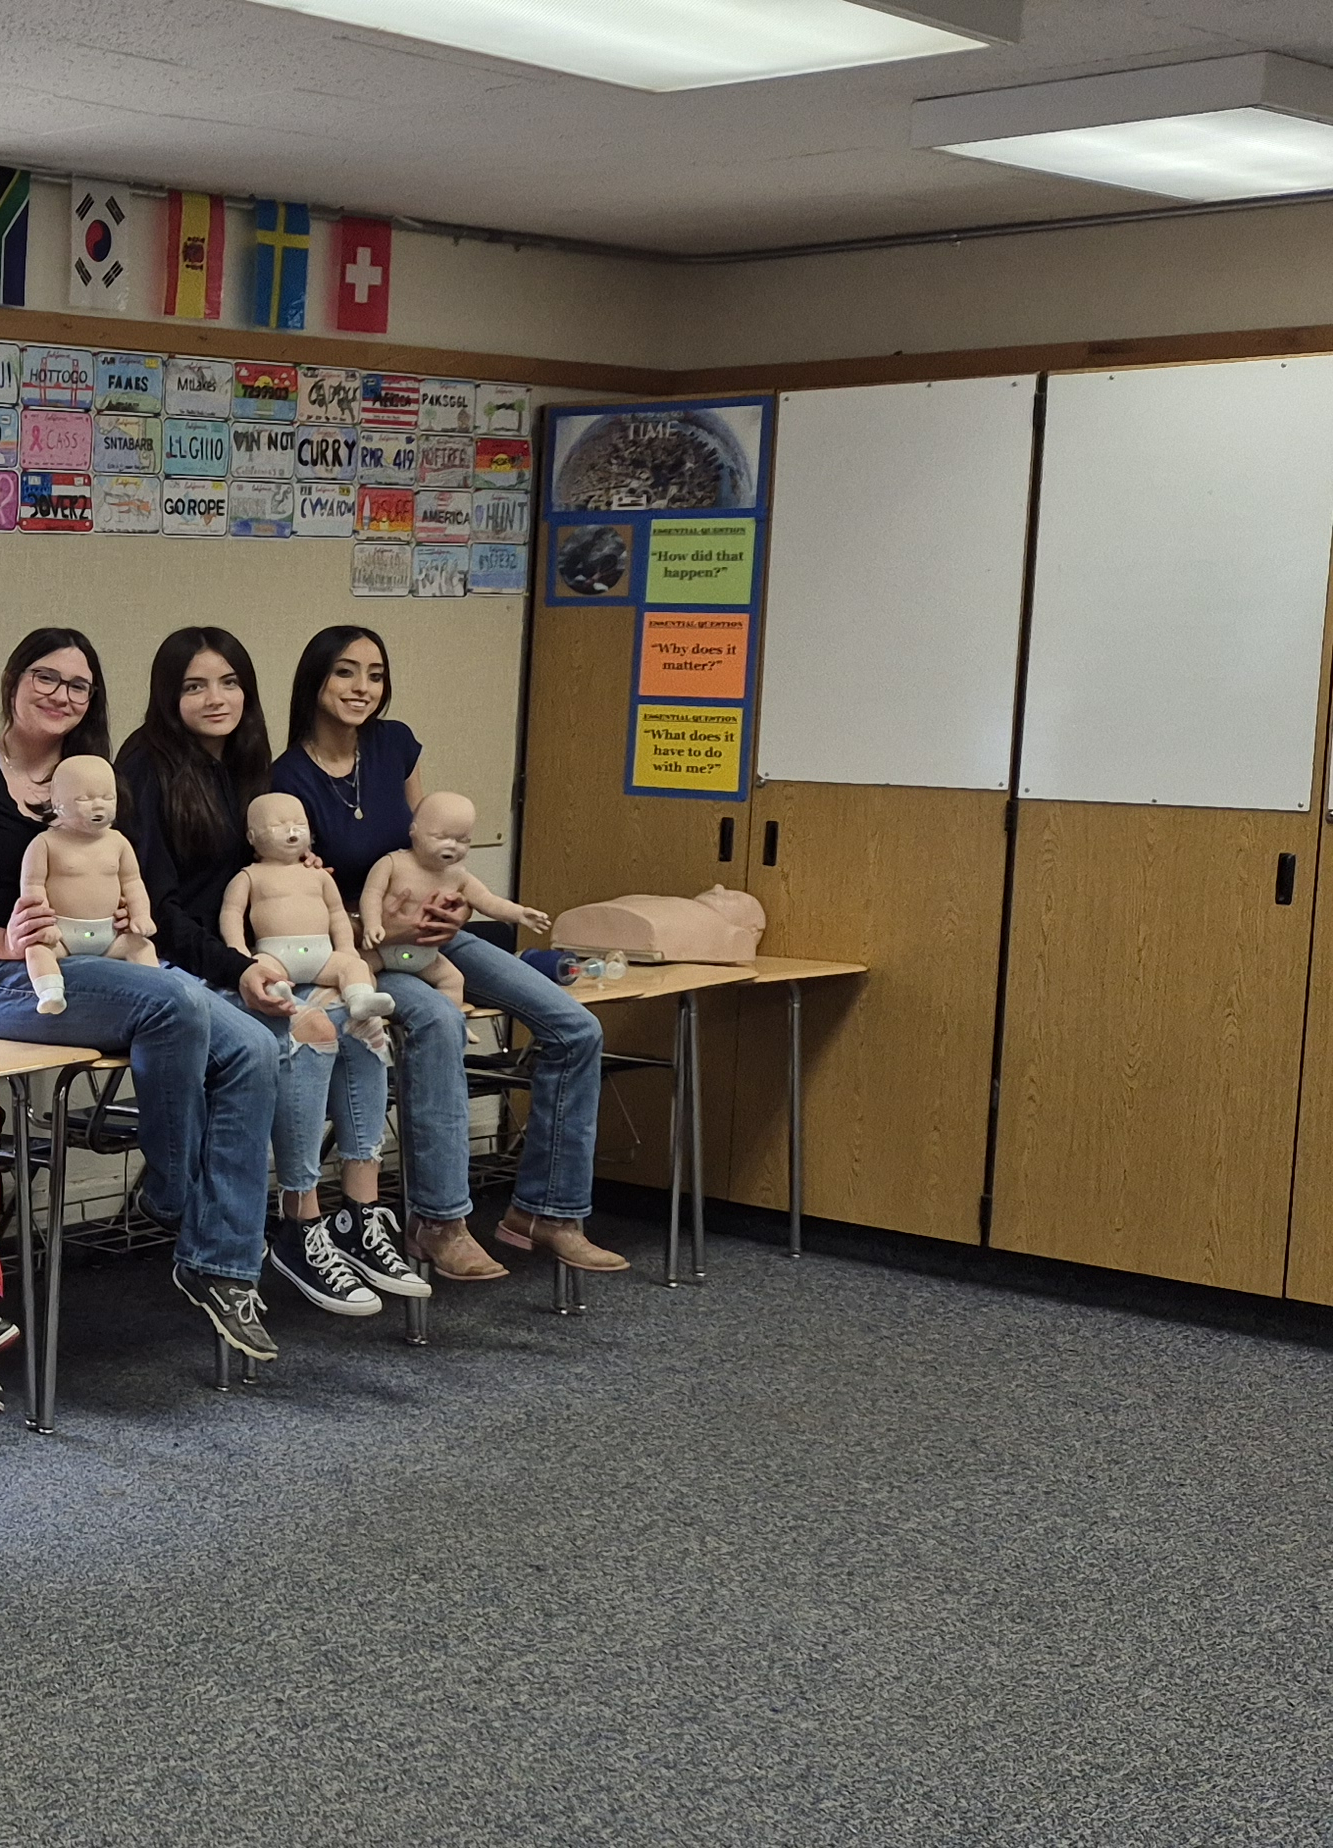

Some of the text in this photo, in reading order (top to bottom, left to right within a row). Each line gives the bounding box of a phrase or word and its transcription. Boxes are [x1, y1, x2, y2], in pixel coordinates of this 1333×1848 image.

[29, 367, 88, 384] HOTTOGO
[627, 420, 679, 440] TIME
[297, 438, 357, 468] CURRY
[422, 510, 470, 525] AMERICA
[691, 550, 713, 562] did
[716, 549, 744, 561] that
[691, 643, 723, 655] does
[727, 643, 737, 656] it
[689, 730, 722, 743] does
[724, 730, 735, 743] it
[653, 744, 723, 758] have to do
[653, 761, 683, 773] with
